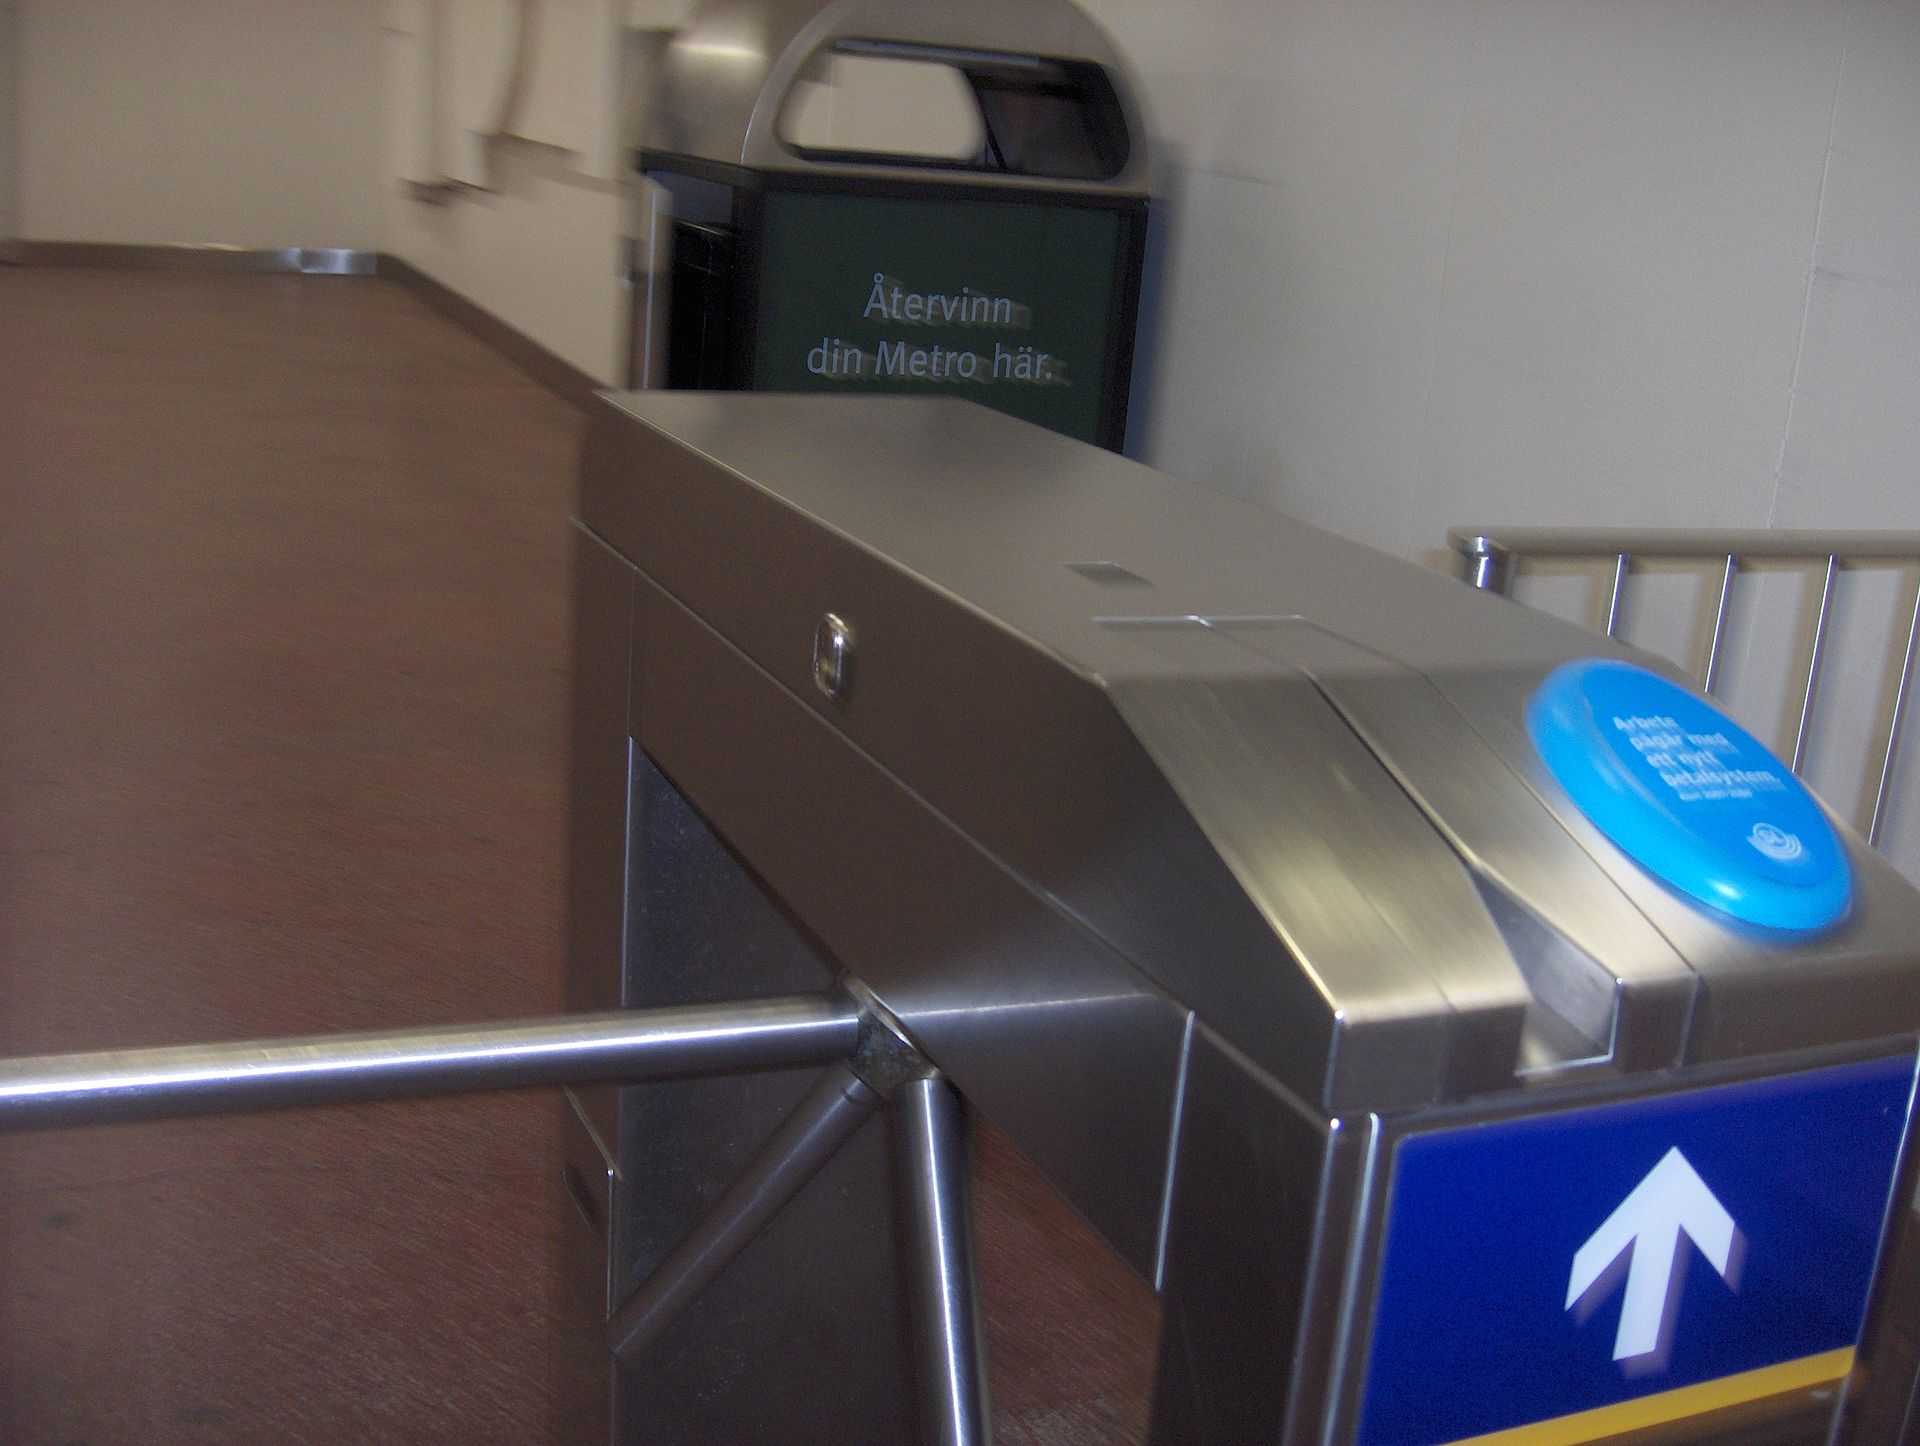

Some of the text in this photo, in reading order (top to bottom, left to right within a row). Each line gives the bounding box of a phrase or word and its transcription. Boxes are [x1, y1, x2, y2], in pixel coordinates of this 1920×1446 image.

[863, 272, 1012, 324] Återvinn
[806, 336, 1053, 380] din Metro här.
